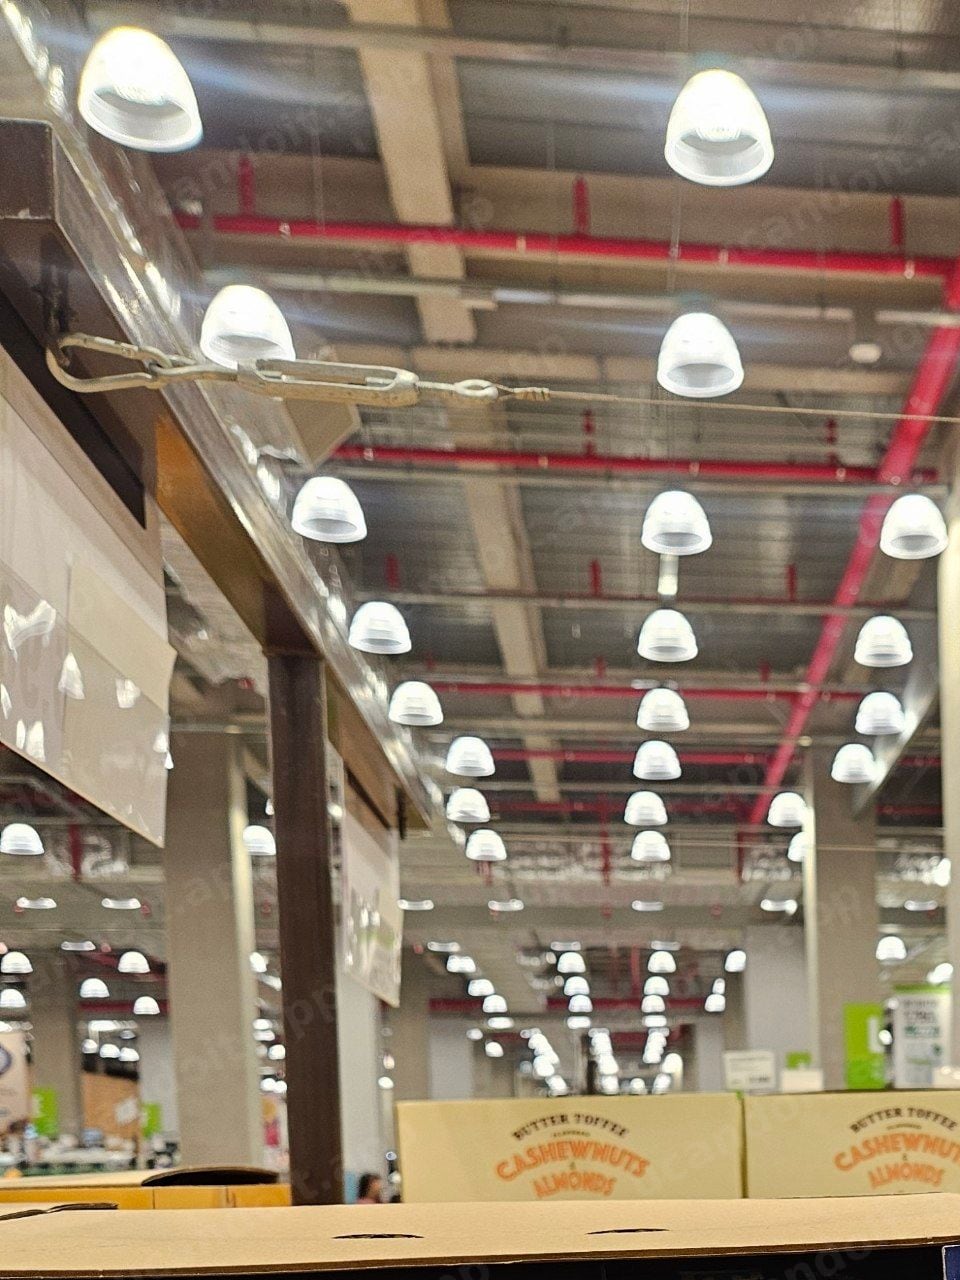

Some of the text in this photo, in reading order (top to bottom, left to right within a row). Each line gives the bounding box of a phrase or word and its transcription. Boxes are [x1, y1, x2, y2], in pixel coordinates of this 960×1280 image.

[512, 1113, 629, 1141] BUTTER TOFFEE
[850, 1107, 959, 1133] BUTTER TOFFEE
[496, 1140, 651, 1182] CASHEWNUTS
[532, 1171, 617, 1199] ALMONDS
[868, 1162, 945, 1189] ALMONDS
